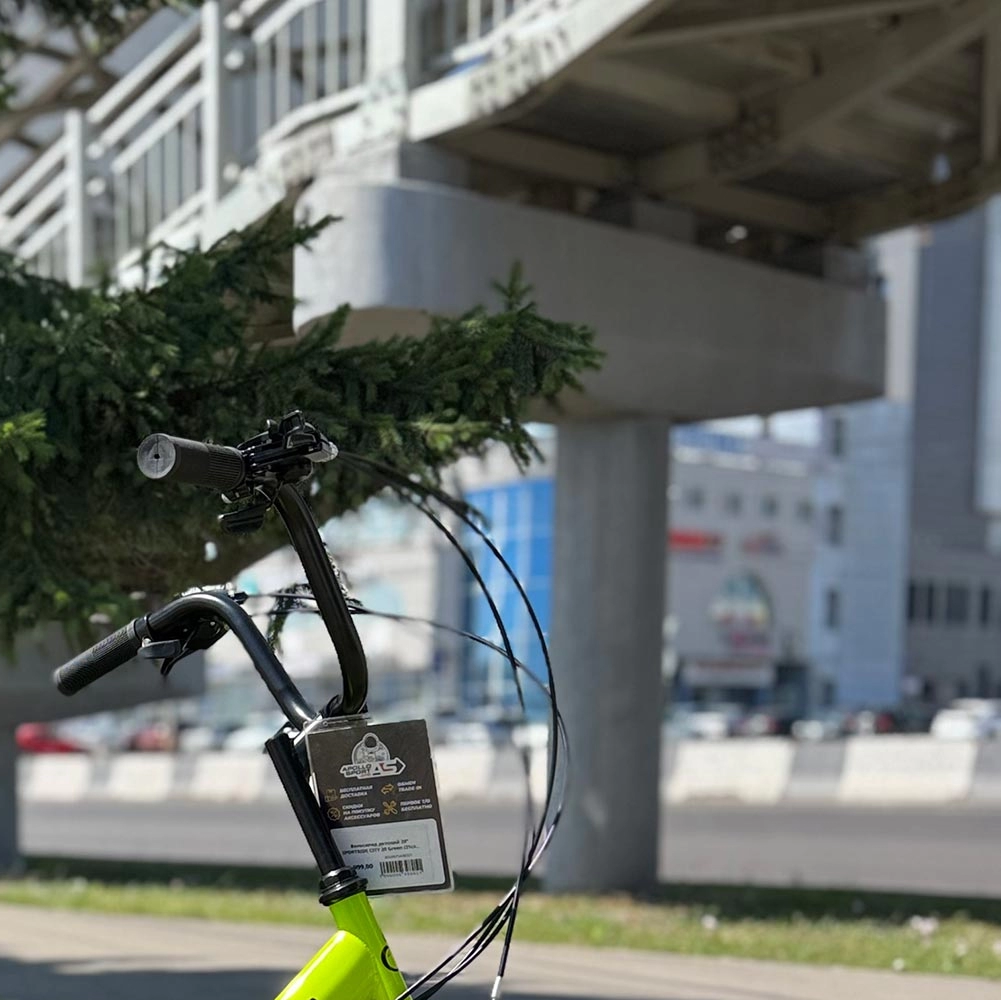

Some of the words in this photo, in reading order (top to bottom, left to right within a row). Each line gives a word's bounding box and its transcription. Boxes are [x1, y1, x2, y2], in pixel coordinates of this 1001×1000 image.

[342, 763, 372, 772] APOLLO
[345, 768, 370, 776] SPORT
[339, 785, 373, 793] БЕСПЛАТНАЯ
[340, 791, 368, 799] ДОСТАВКА
[351, 807, 376, 815] ПОКУПКУ
[401, 804, 433, 812] БЕСПЛАТНО
[343, 812, 381, 821] АКСЕССУАРОВ
